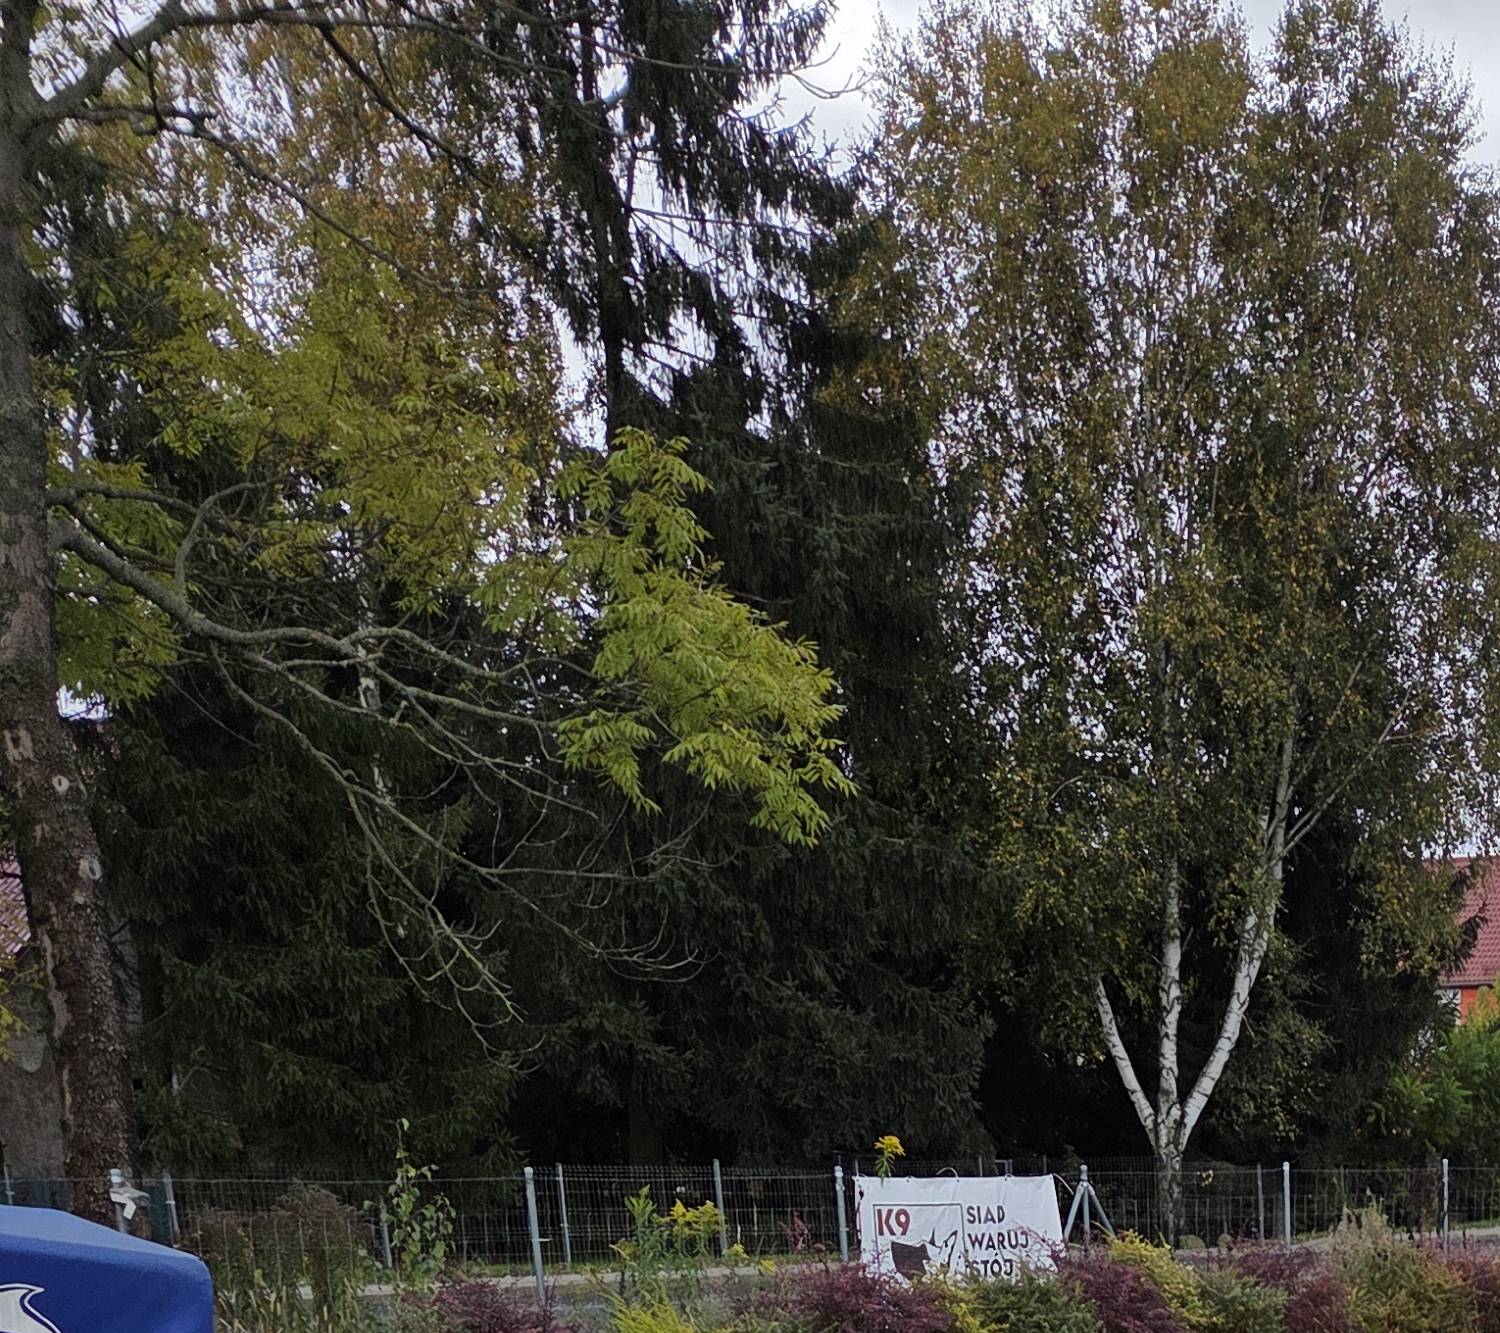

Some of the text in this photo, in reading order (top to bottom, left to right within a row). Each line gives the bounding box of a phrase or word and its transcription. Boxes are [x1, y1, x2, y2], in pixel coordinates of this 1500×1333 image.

[877, 1208, 910, 1236] K9
[966, 1205, 1005, 1224] SIAD
[967, 1230, 1029, 1250] WARUJ
